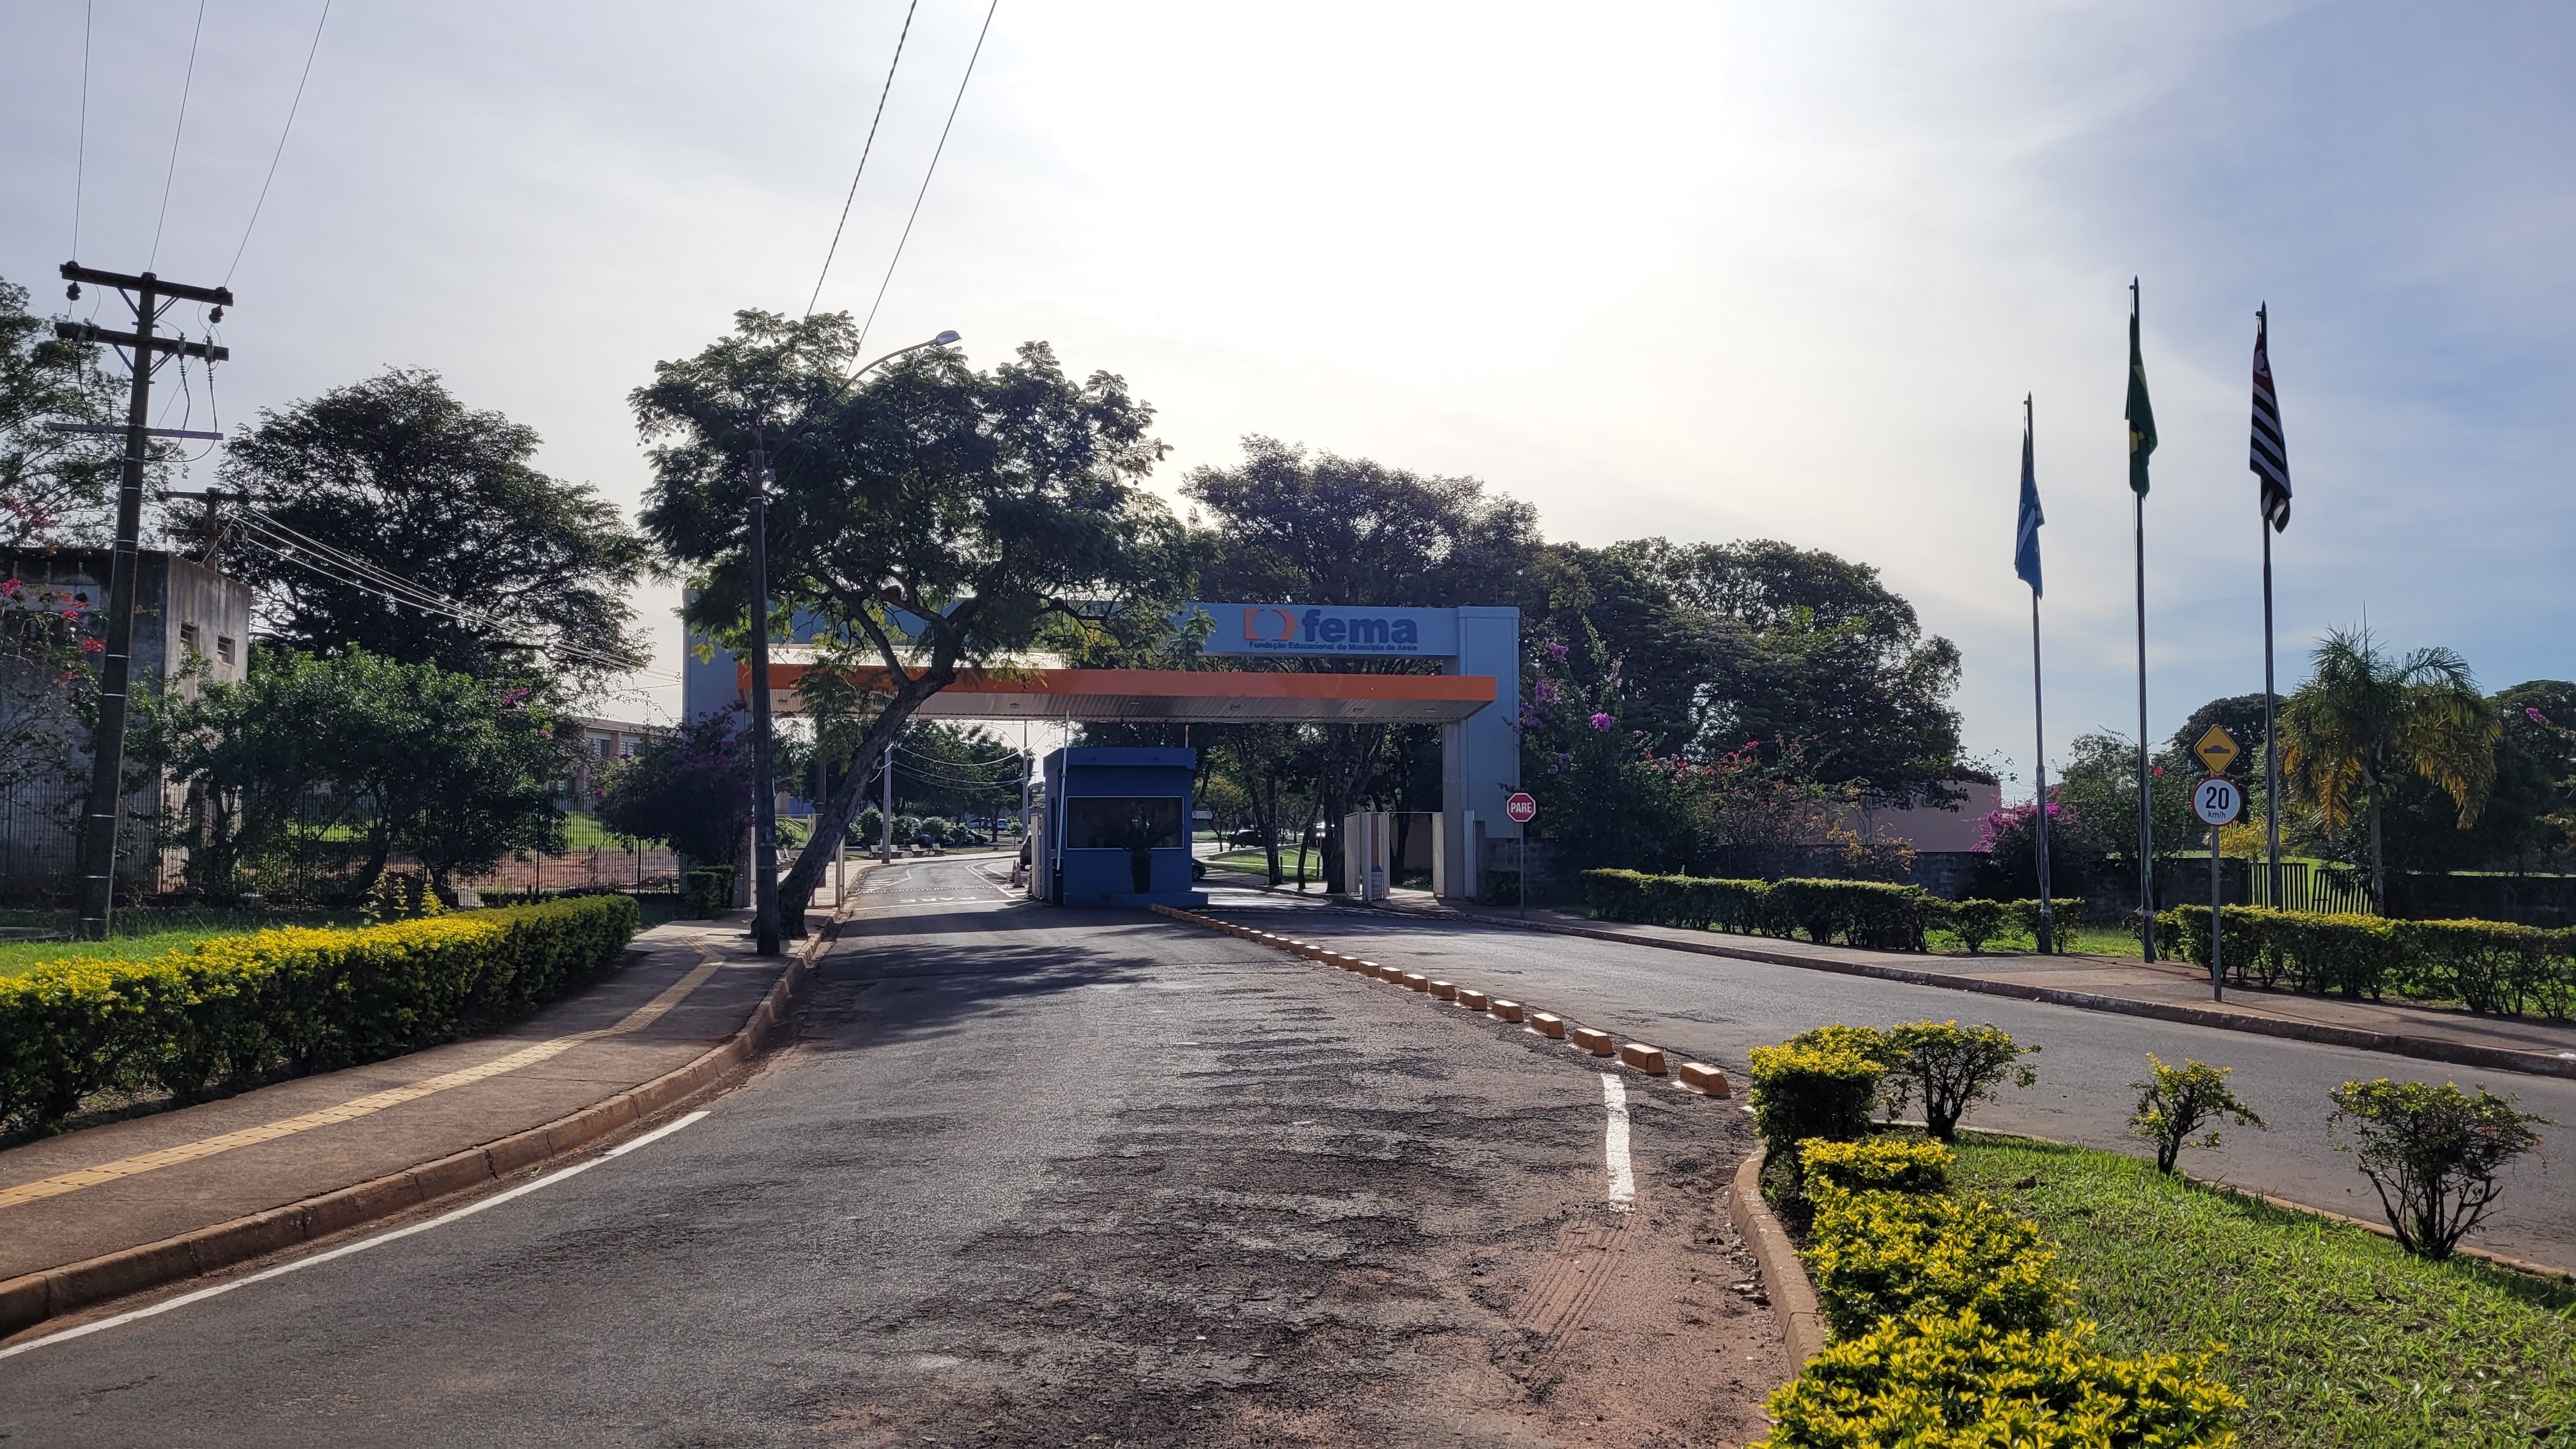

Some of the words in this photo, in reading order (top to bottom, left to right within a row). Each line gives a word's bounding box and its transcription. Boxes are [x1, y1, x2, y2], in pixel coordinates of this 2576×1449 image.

[1302, 609, 1418, 643] fema
[1250, 641, 1287, 650] Fundação
[2205, 786, 2230, 810] 20
[1510, 802, 1532, 813] PARE
[2208, 810, 2226, 819] km/h
